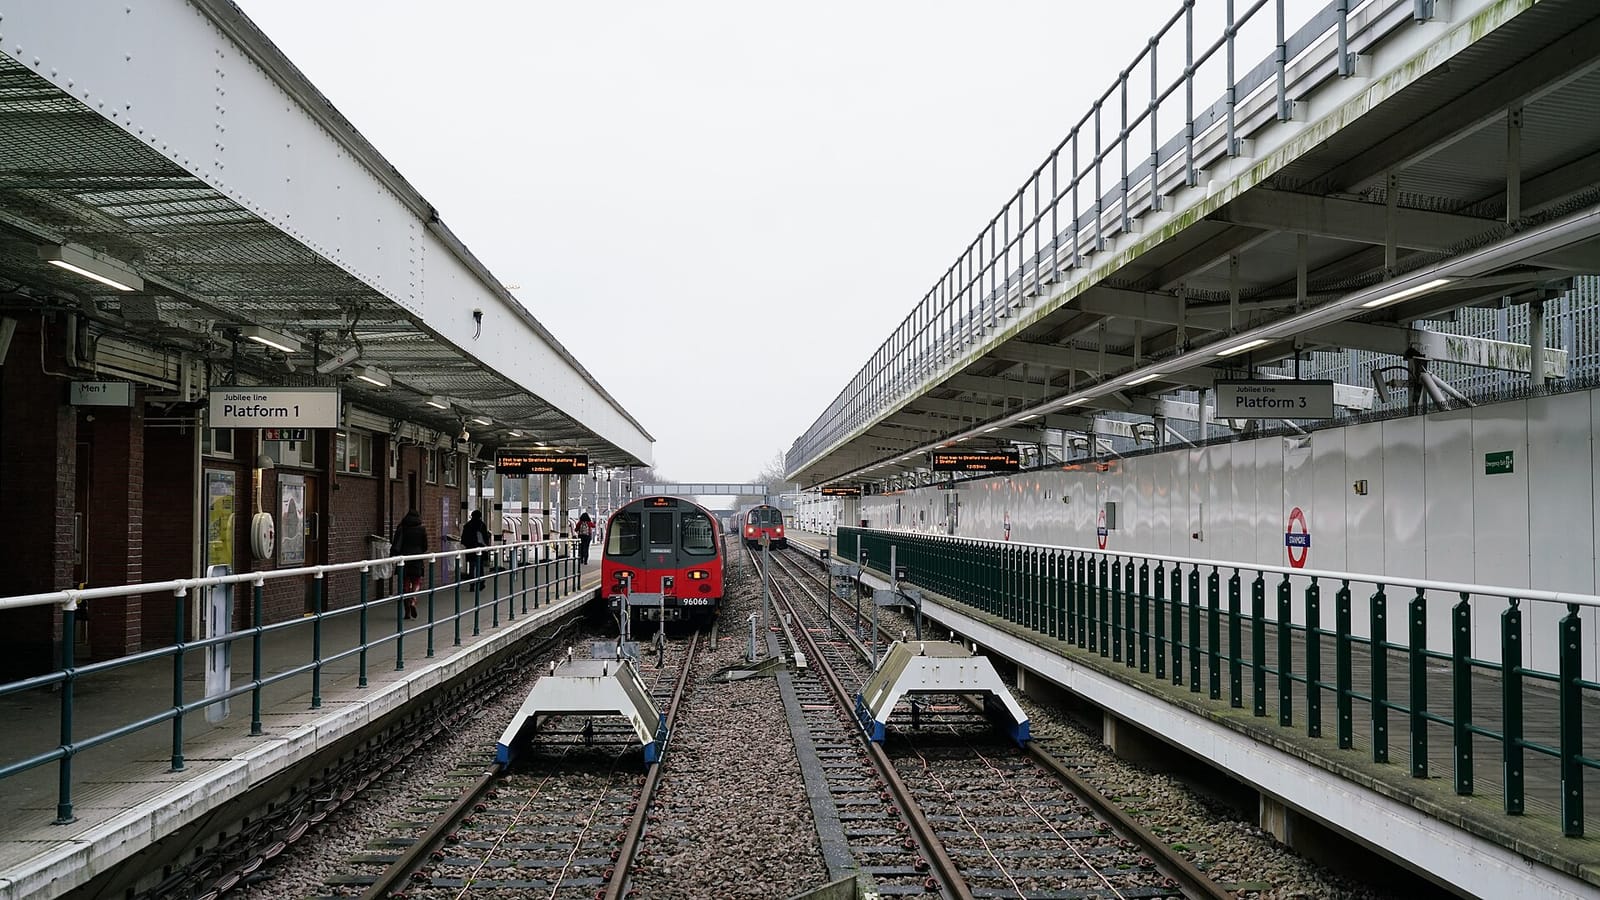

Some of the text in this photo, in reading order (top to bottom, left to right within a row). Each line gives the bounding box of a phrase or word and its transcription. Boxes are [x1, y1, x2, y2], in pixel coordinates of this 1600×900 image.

[81, 384, 100, 392] Men
[1236, 396, 1307, 408] Platform 3
[224, 404, 300, 418] Platform 1
[1289, 536, 1306, 544] STANMORE
